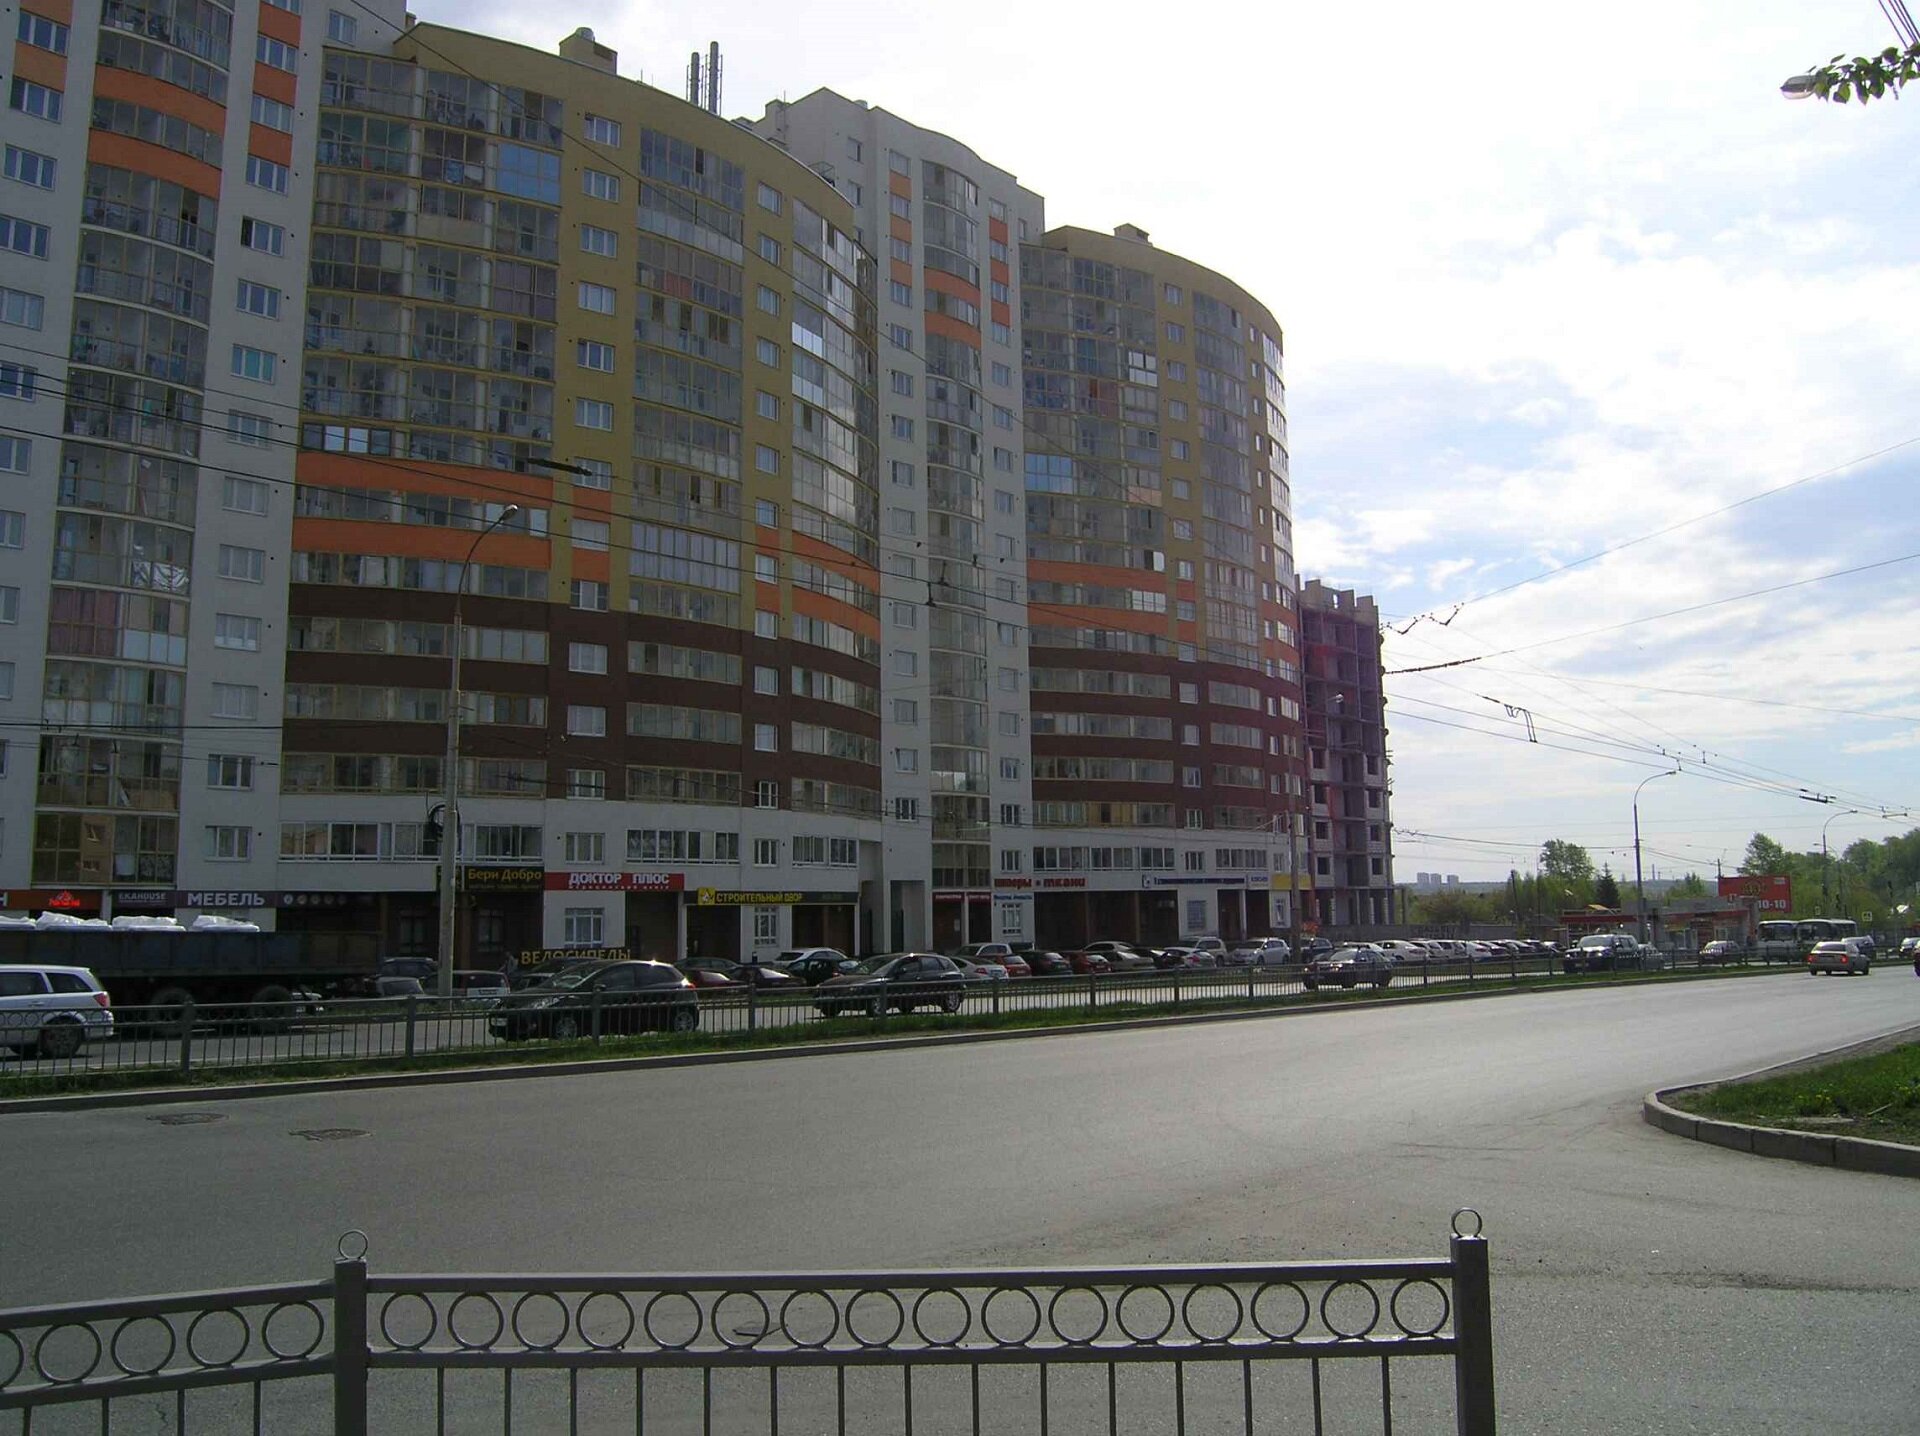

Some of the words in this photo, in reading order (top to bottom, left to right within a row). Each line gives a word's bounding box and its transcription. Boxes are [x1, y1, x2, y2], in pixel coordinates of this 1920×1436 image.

[468, 868, 498, 883] Бери
[501, 868, 543, 883] Добро
[569, 873, 622, 886] ДОКТОР
[633, 873, 670, 884] ПЛЮС
[187, 893, 265, 906] МЕБЕЛЬ
[715, 891, 783, 903] СТРОИТЕЛЬНЫЙ
[783, 893, 803, 902] ДВОР
